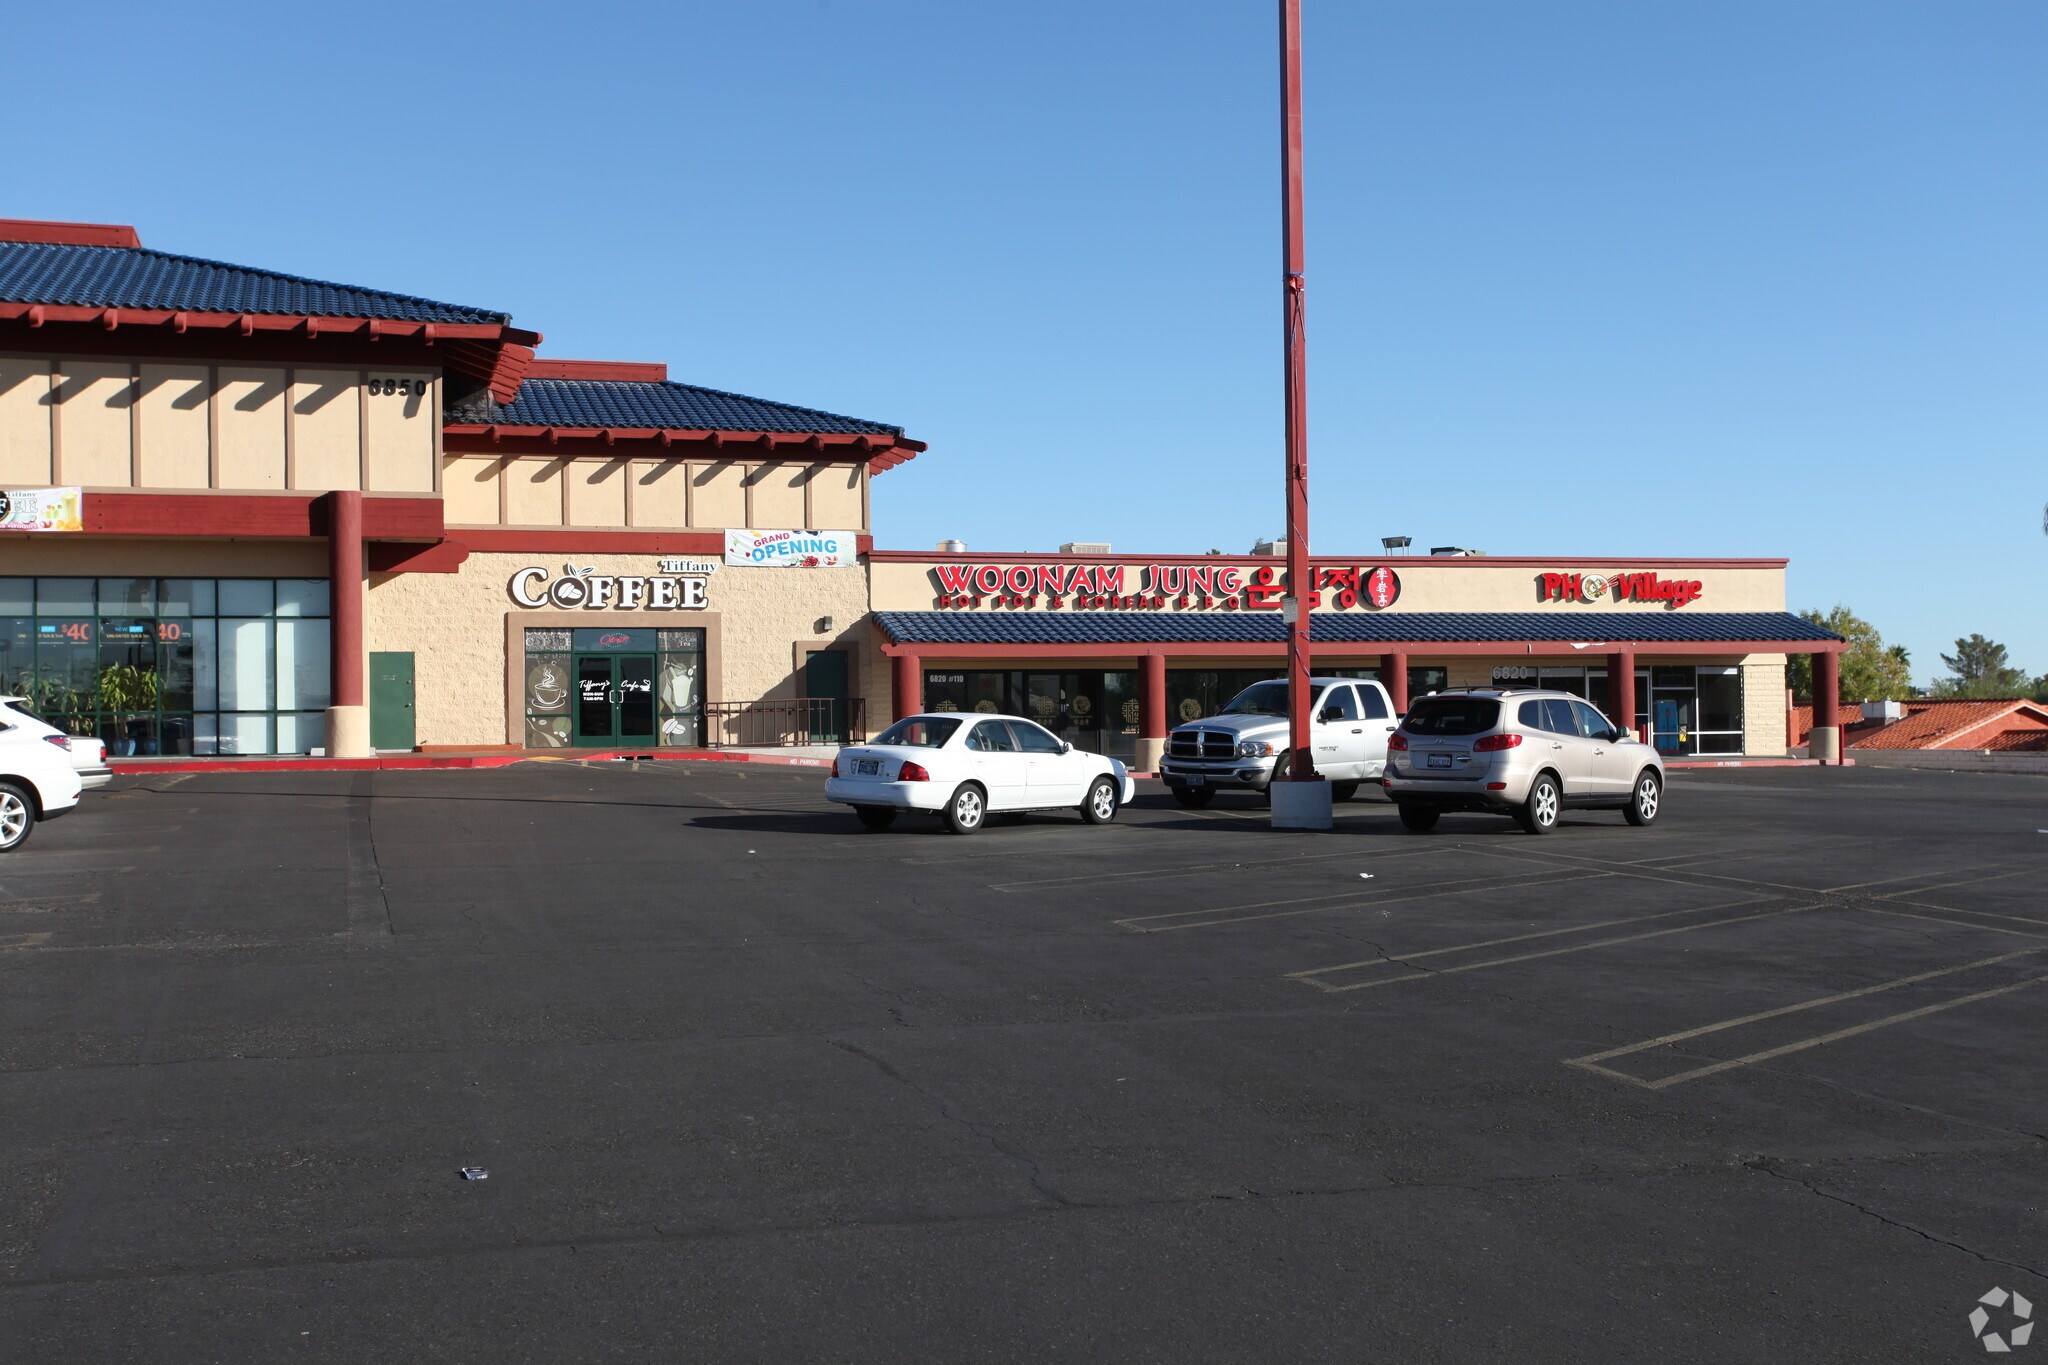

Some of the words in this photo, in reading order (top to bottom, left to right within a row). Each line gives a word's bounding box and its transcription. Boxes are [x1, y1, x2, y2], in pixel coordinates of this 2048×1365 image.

[368, 379, 427, 397] 6850
[753, 532, 790, 548] GRAND
[751, 539, 838, 562] OPENING
[662, 559, 718, 573] Tiffany
[935, 564, 1125, 594] WOONAM
[1140, 564, 1243, 595] JUNG
[1617, 572, 1703, 608] Village
[940, 595, 983, 607] HOT
[997, 595, 1038, 607] POT
[1052, 595, 1064, 608] &
[1079, 595, 1165, 608] KOREAN
[929, 674, 947, 683] 6820
[948, 675, 964, 683] #110
[1492, 666, 1528, 679] 6820
[579, 680, 611, 692] Tiffany's
